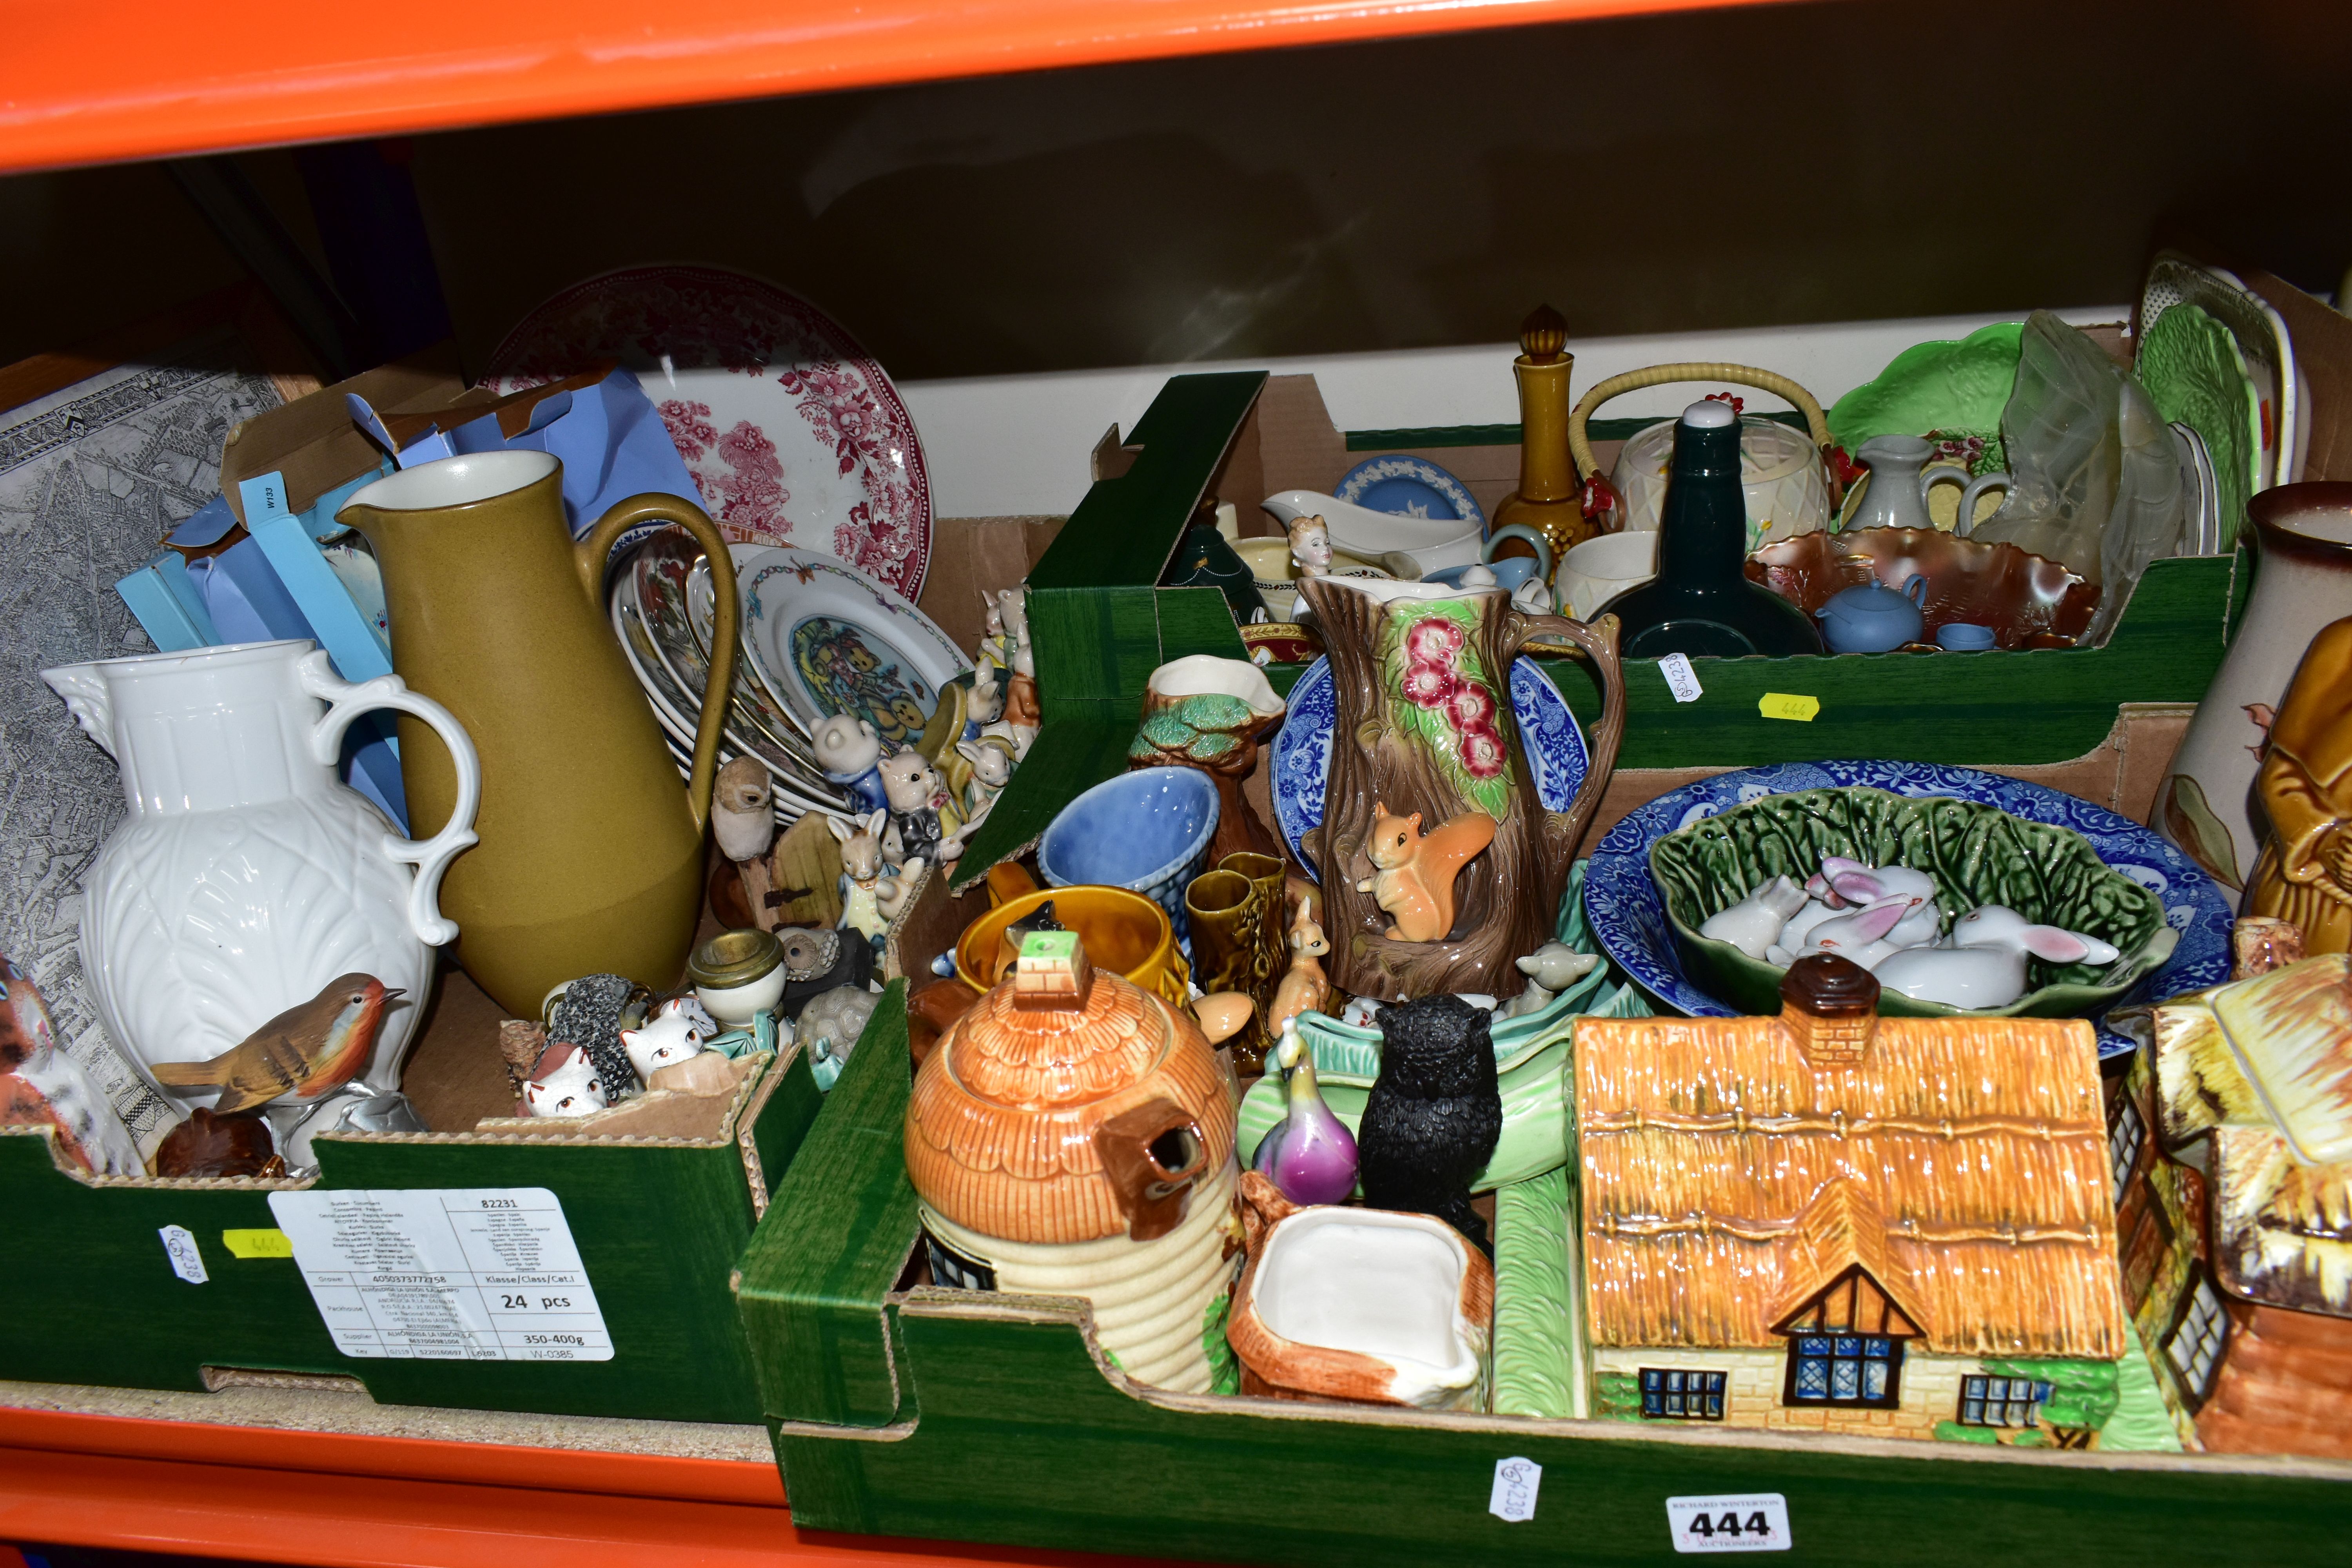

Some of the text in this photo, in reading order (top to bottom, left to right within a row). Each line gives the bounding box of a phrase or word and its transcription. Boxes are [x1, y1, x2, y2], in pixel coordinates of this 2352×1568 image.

[265, 488, 275, 508] W133
[1782, 702, 1805, 715] 444
[481, 1200, 518, 1208] 82231
[501, 1294, 571, 1310] 24 pcs
[524, 1335, 584, 1346] 350-400g
[1720, 1499, 1779, 1508] WINTERTON
[1689, 1511, 1771, 1537] 444
